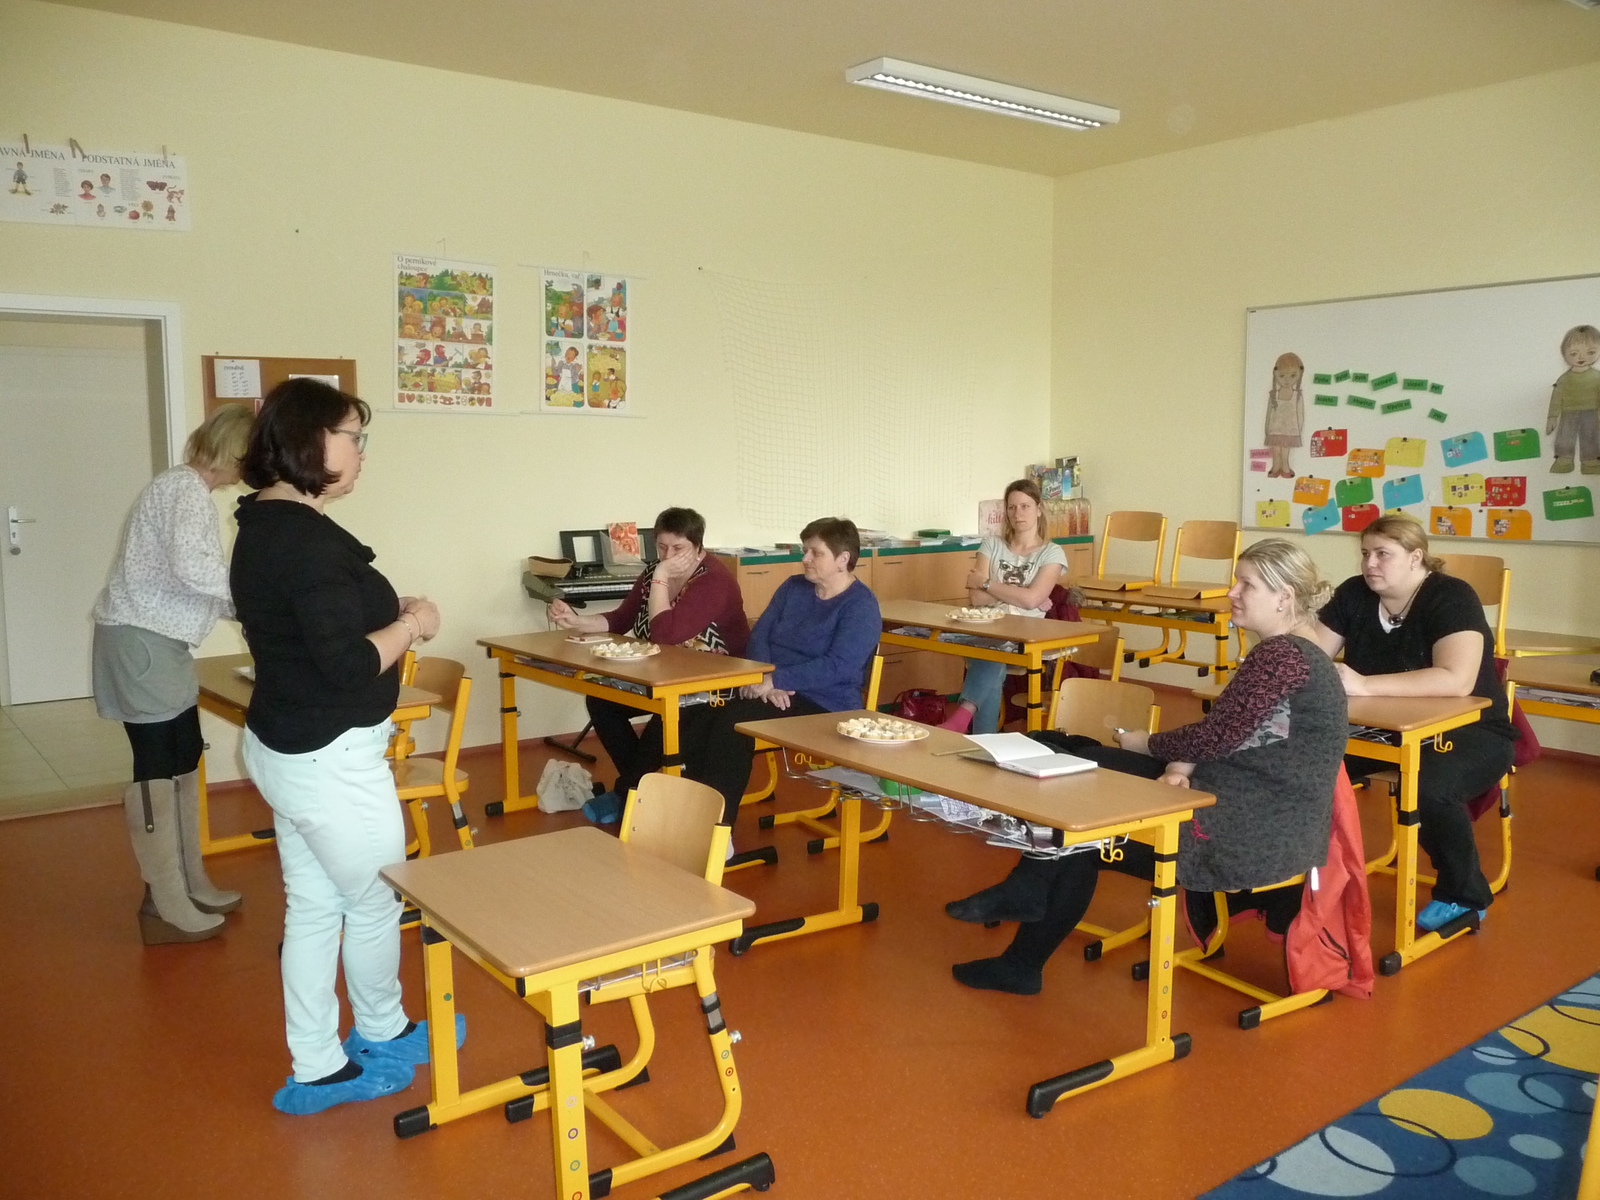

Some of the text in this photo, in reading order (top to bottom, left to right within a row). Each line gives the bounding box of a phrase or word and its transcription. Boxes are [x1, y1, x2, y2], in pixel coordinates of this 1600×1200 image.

[30, 149, 65, 161] JMÉNA
[81, 153, 176, 169] PODSTATNÁ JMÉNA
[396, 255, 404, 263] O
